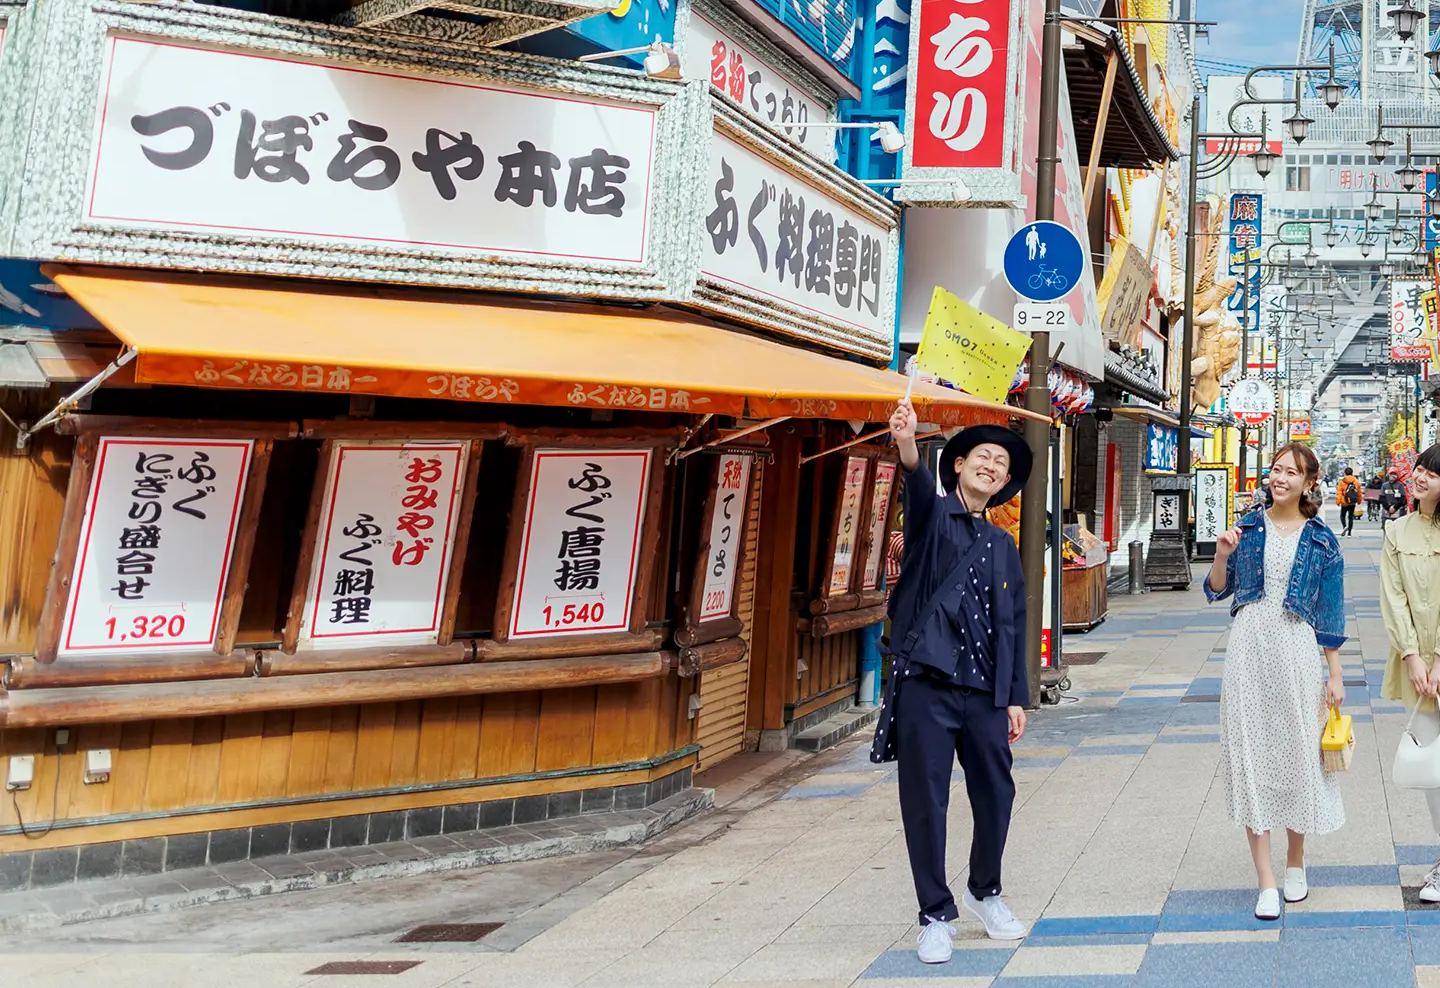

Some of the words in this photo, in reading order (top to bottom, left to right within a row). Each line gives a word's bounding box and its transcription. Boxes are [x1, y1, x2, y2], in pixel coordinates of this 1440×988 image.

[710, 40, 808, 143] 名物てっちり
[131, 104, 631, 218] づぼらや本店
[706, 157, 882, 318] ふぐ料理専門
[195, 360, 378, 389] ふぐなら日本一
[427, 375, 519, 401] づぼらや
[567, 384, 711, 410] ふぐなら日本一
[112, 451, 173, 600] にぎり盛合せ
[173, 451, 216, 520] ふぐ
[392, 457, 443, 567] おみやげ
[554, 462, 612, 591] ふぐ唐揚
[1160, 497, 1174, 528] ぎふや
[329, 513, 382, 624] ふぐ料理
[105, 614, 186, 643] 1,320
[542, 602, 605, 628] 1,540
